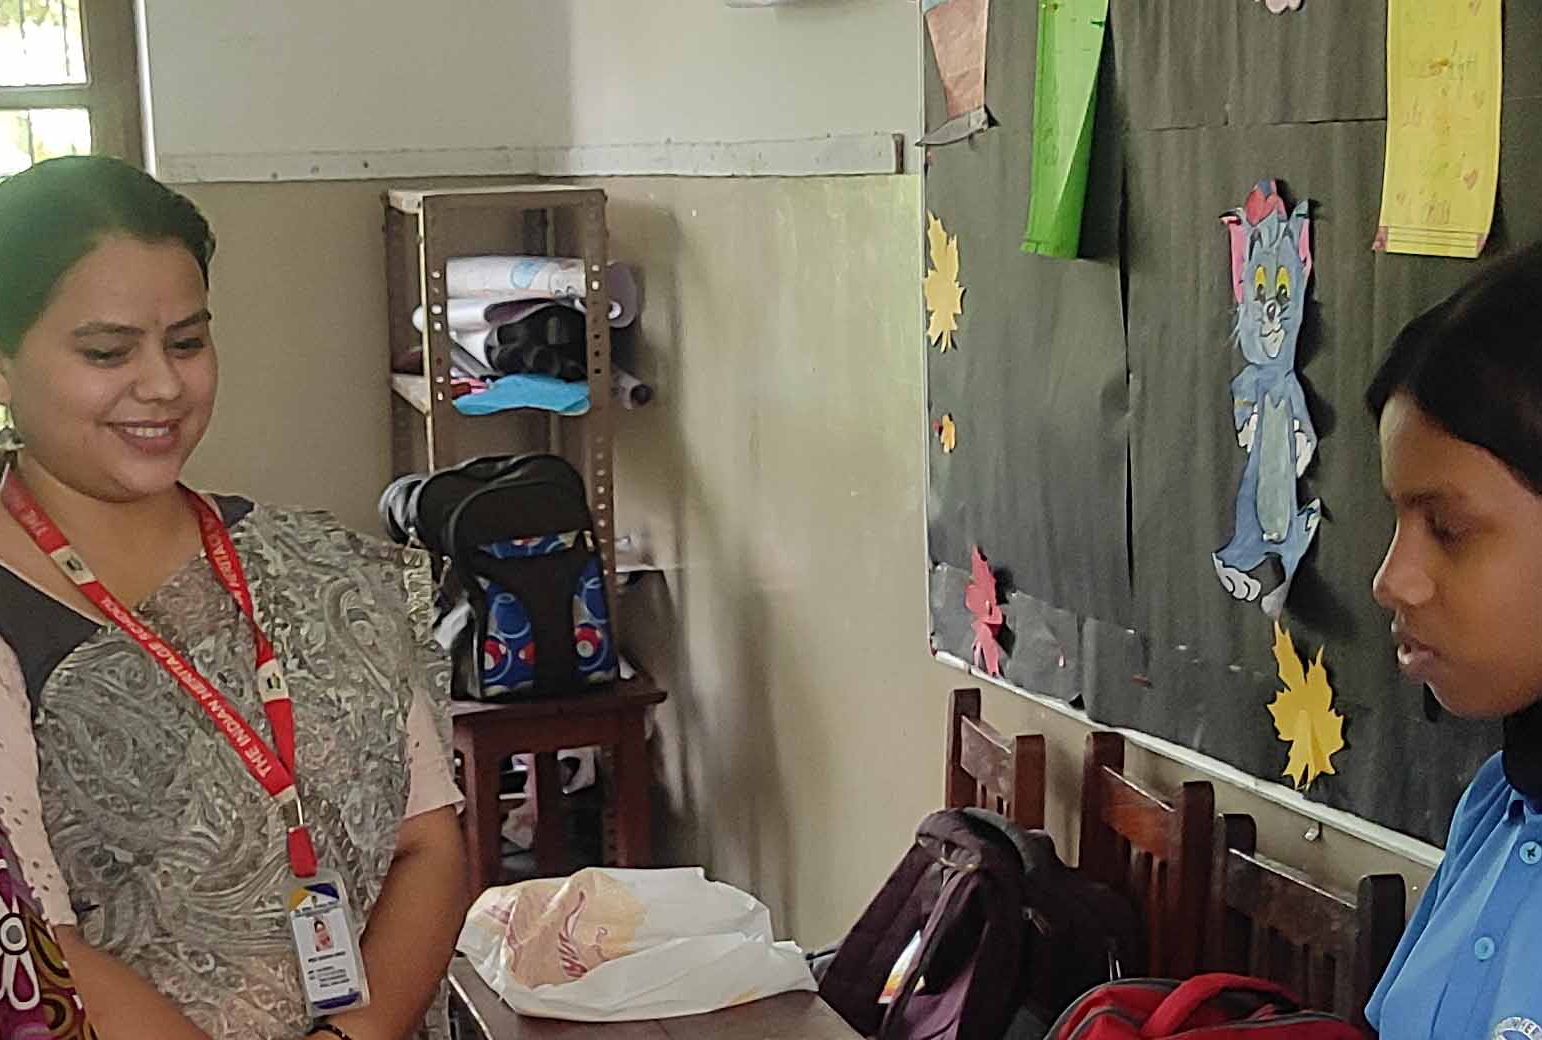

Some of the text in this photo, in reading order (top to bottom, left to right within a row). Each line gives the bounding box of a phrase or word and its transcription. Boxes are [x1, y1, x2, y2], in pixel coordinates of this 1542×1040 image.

[147, 639, 213, 701] HERITAGE
[207, 697, 251, 748] INDIAN
[246, 745, 272, 778] THE
